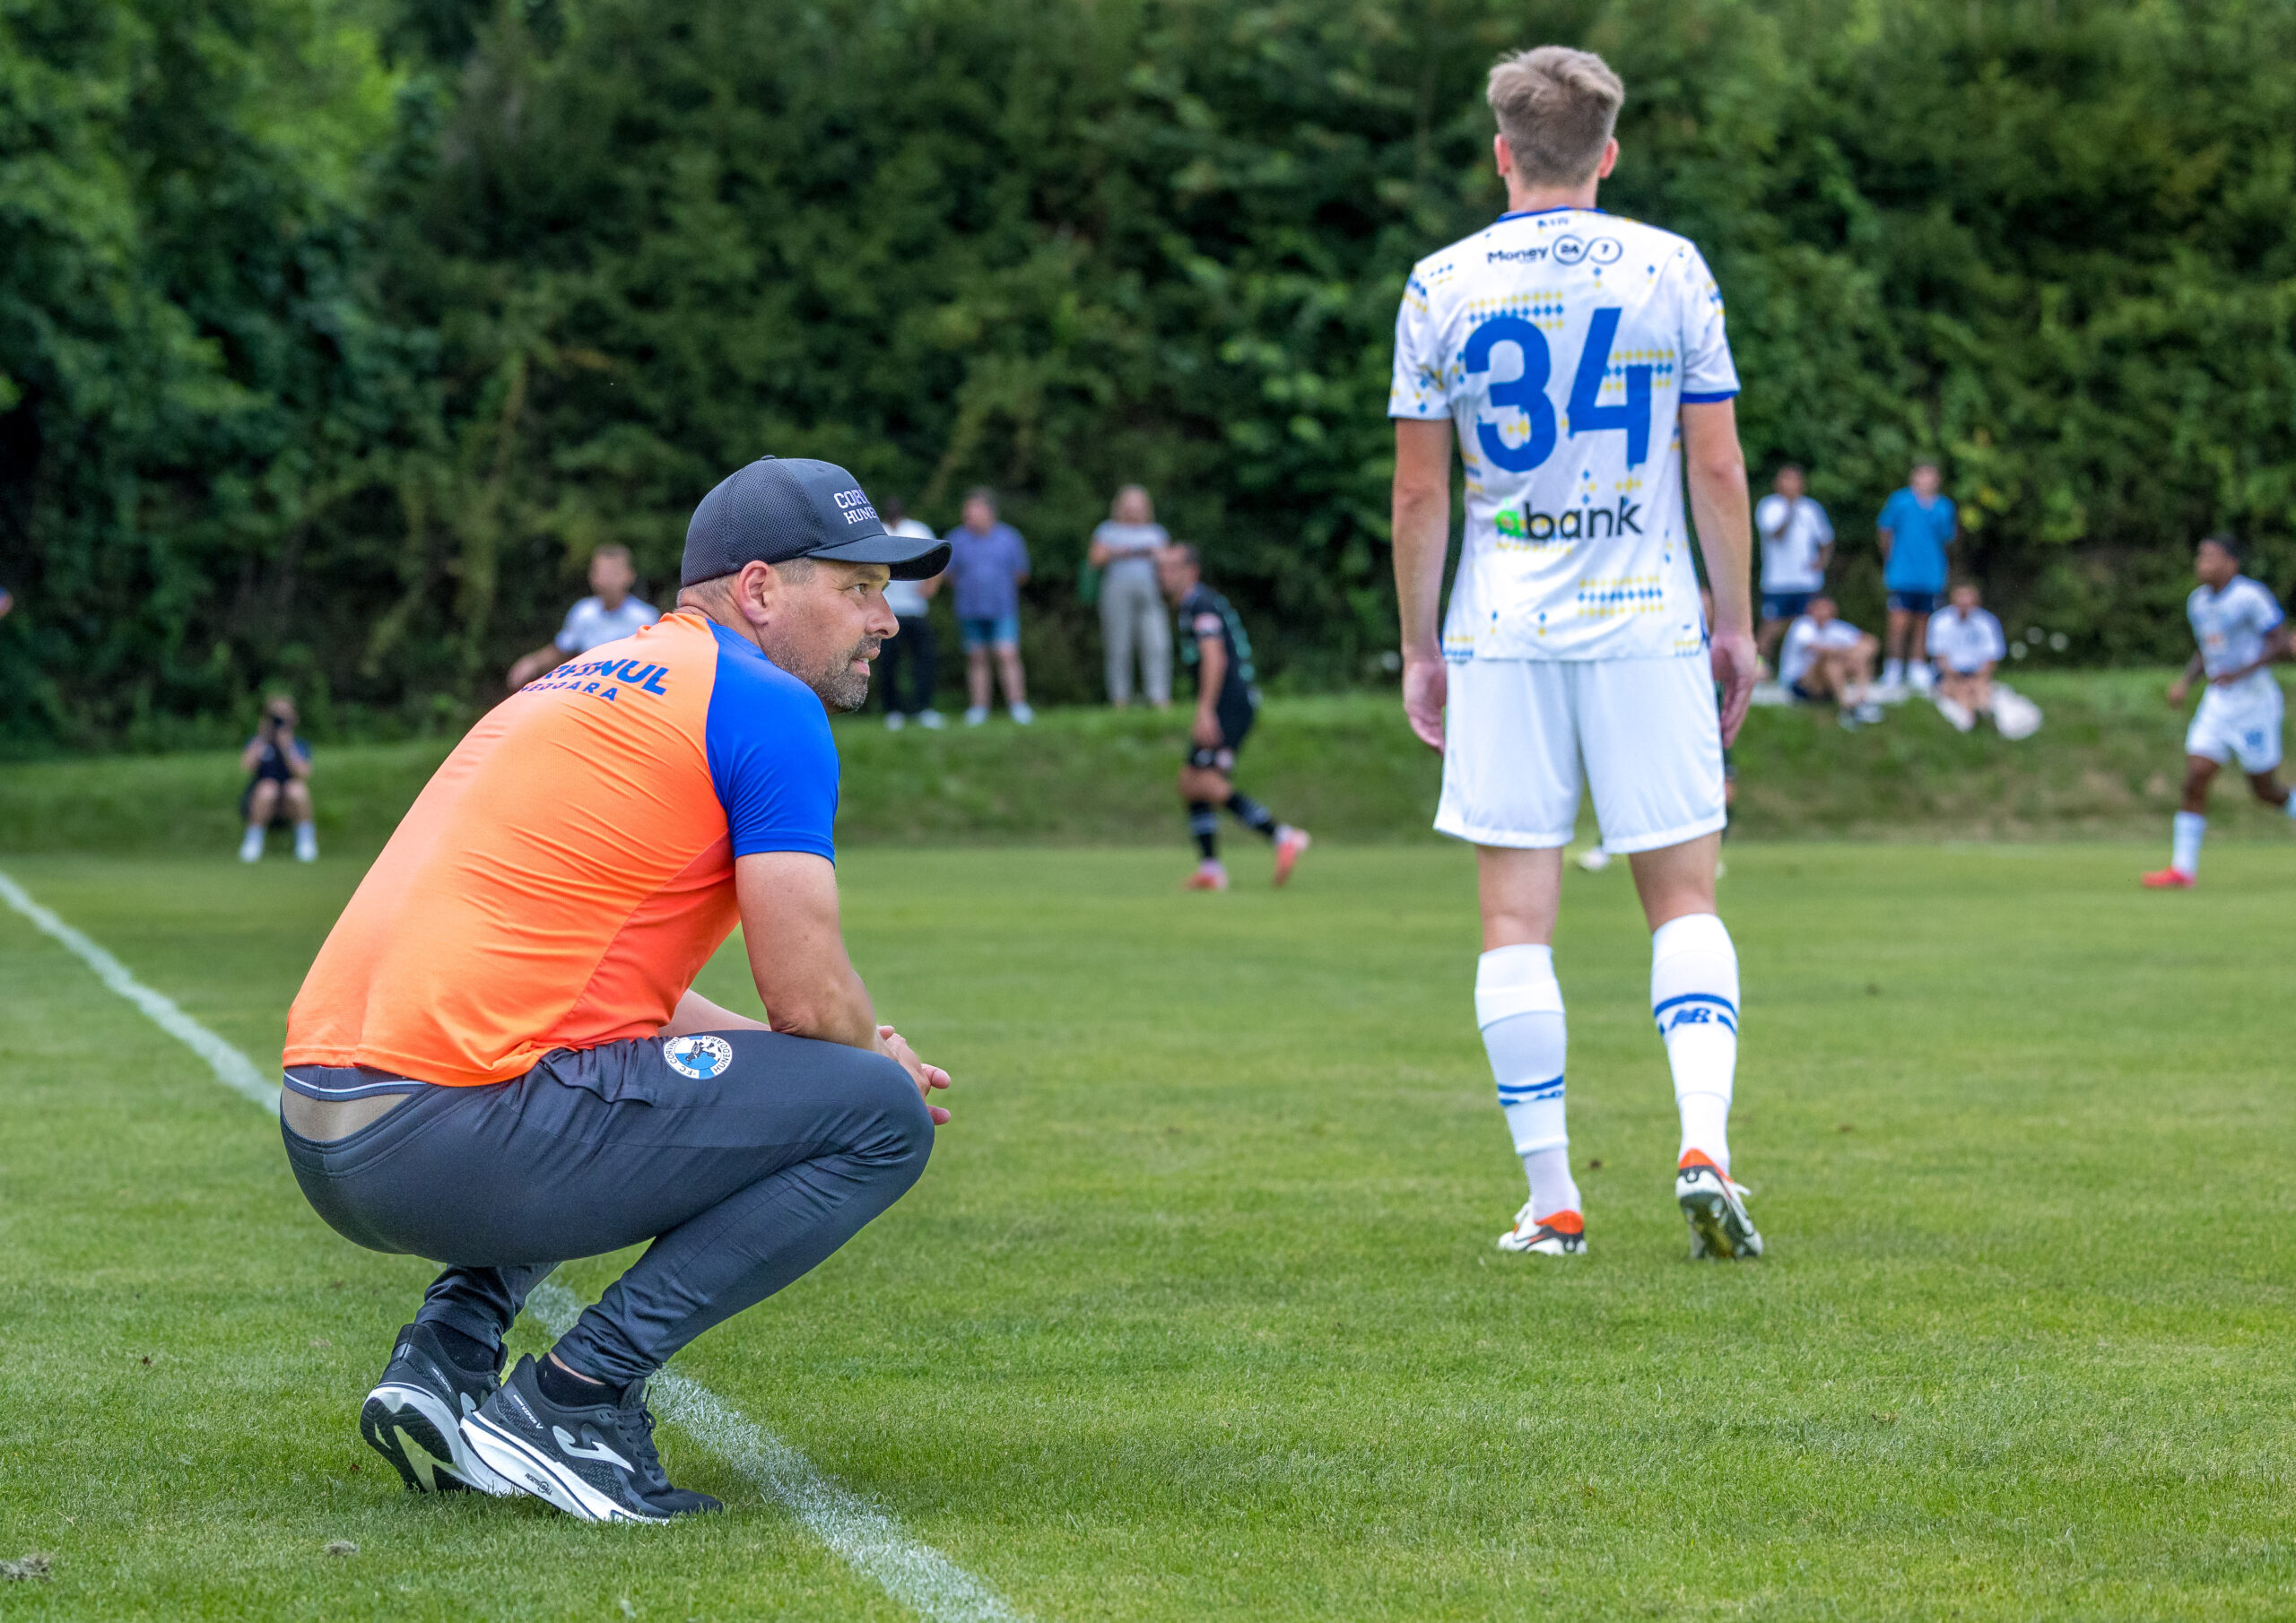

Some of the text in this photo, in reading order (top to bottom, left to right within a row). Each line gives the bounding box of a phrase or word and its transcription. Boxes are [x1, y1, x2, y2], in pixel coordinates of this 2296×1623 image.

[1486, 247, 1549, 264] Money
[1601, 243, 1610, 255] 7
[1464, 307, 1652, 473] 34
[705, 1036, 731, 1073] HUNEDOARA
[679, 1065, 693, 1076] FC
